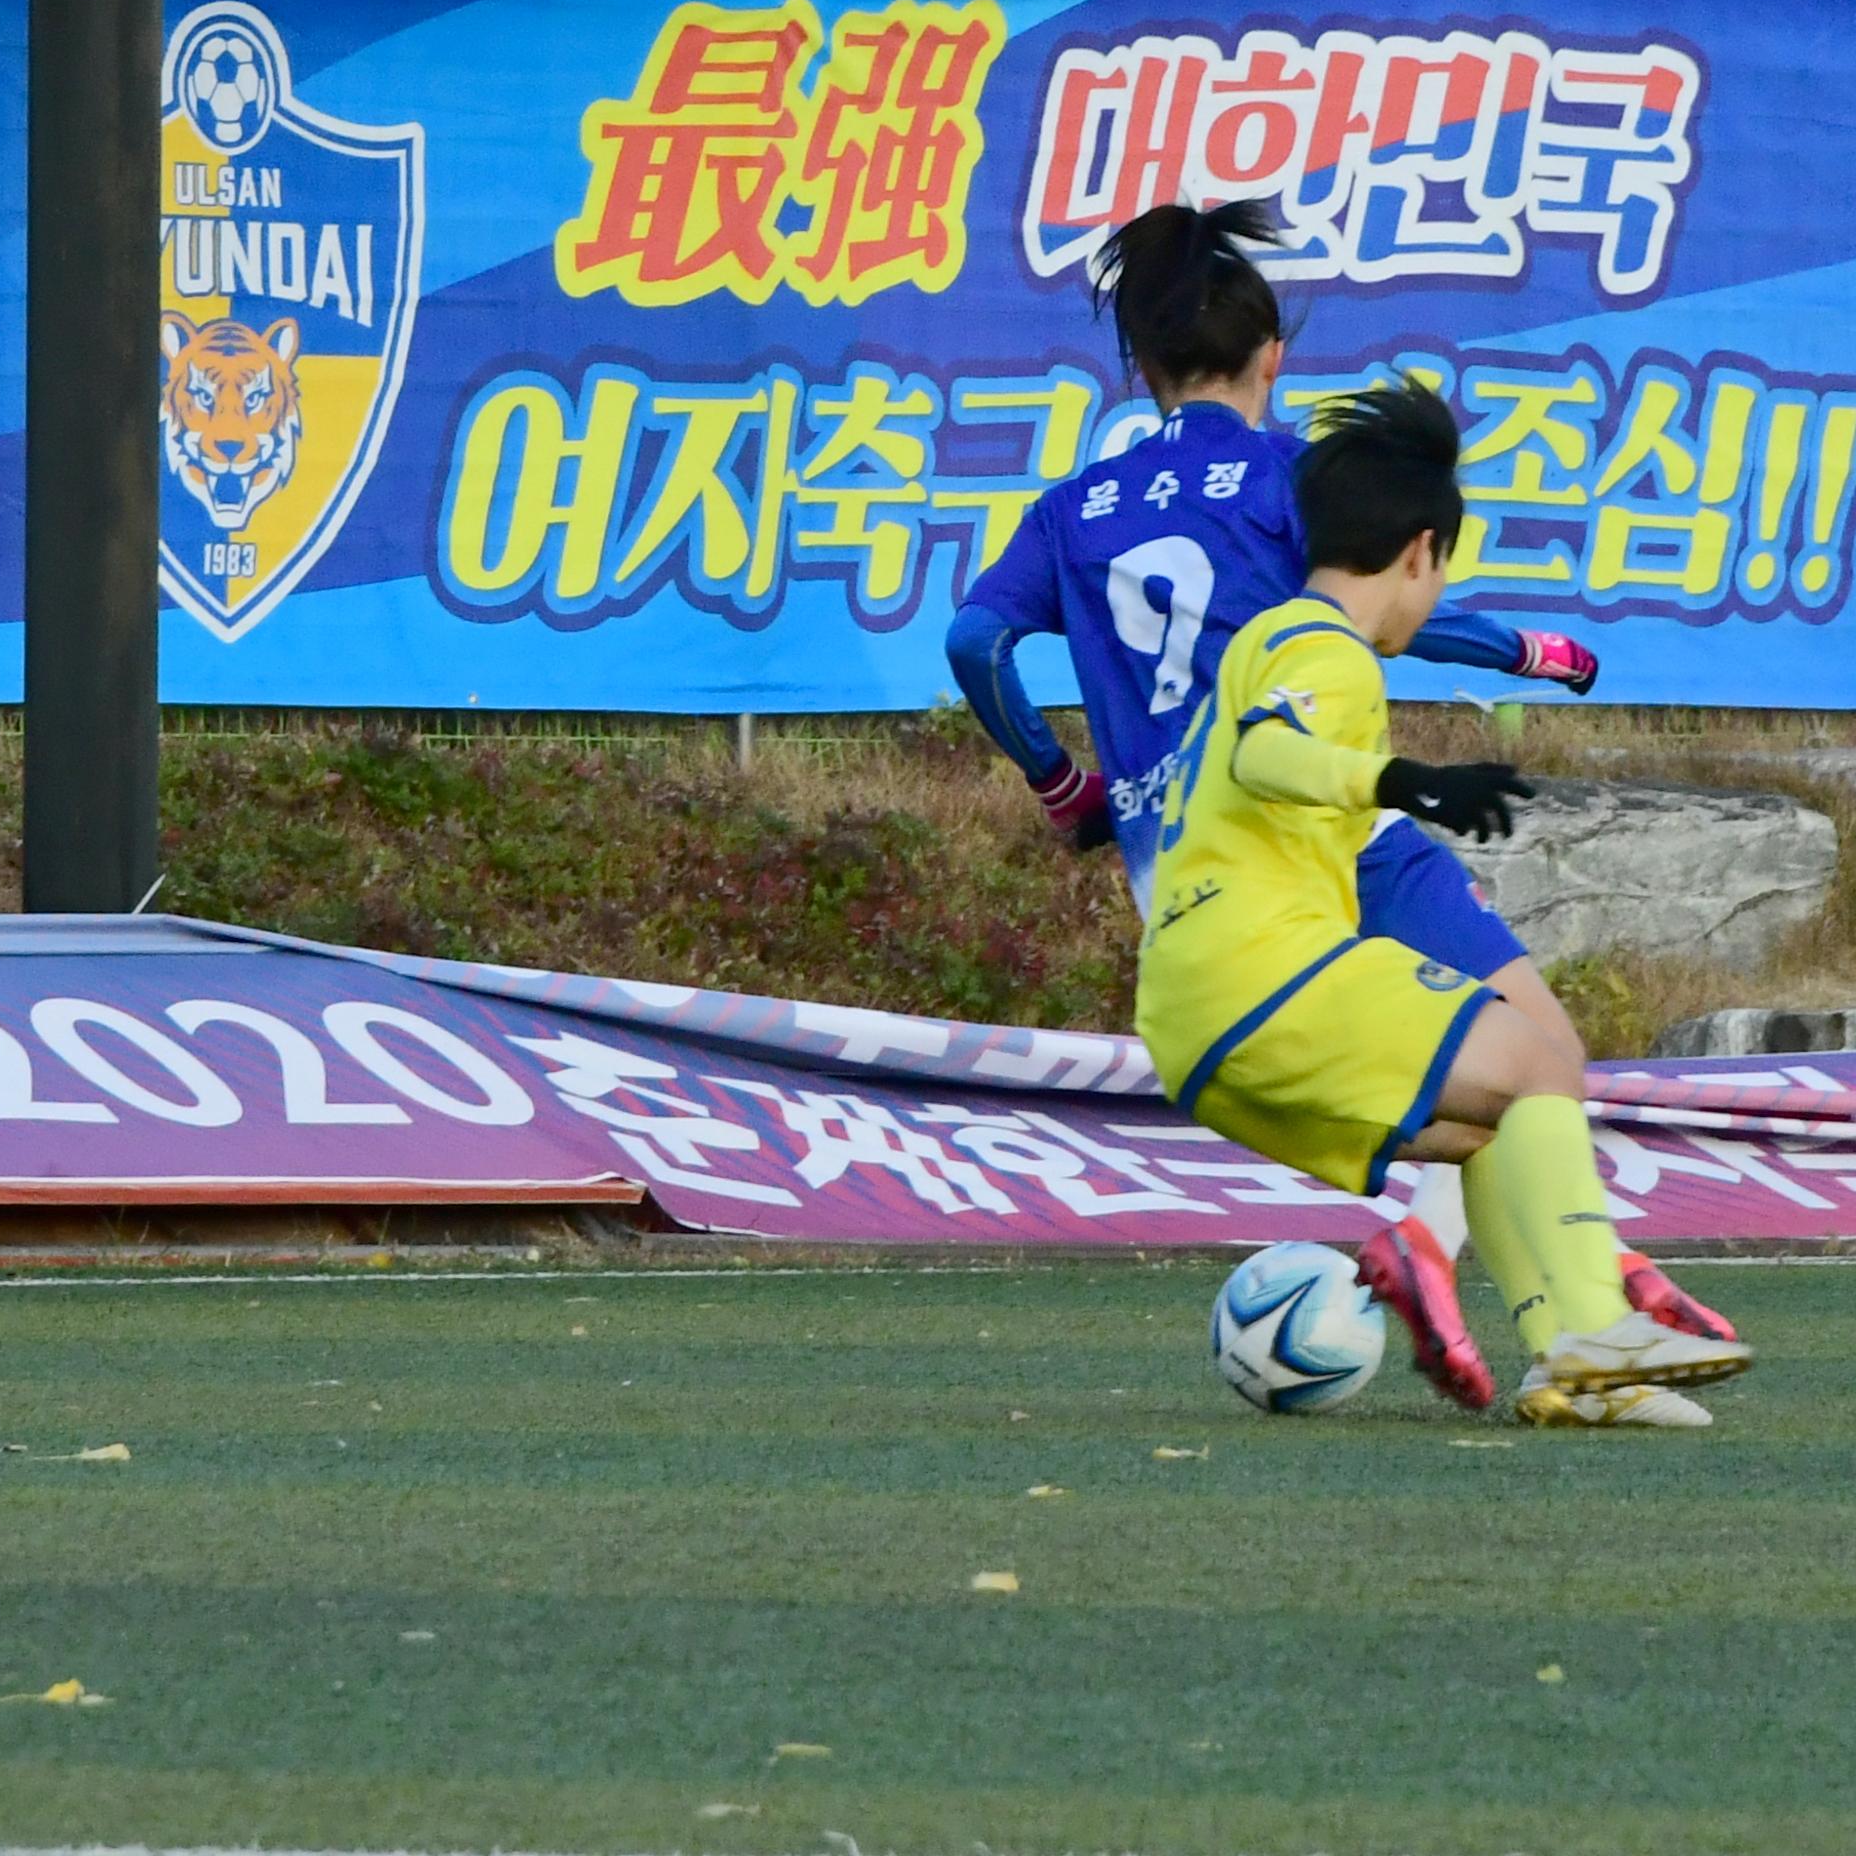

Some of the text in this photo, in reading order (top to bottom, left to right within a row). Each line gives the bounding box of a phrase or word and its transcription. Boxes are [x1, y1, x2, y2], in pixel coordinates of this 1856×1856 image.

[173, 161, 283, 209] ULSAN
[568, 8, 1692, 294] 最強 대한민국
[202, 542, 258, 578] 1983
[1105, 534, 1216, 716] 9
